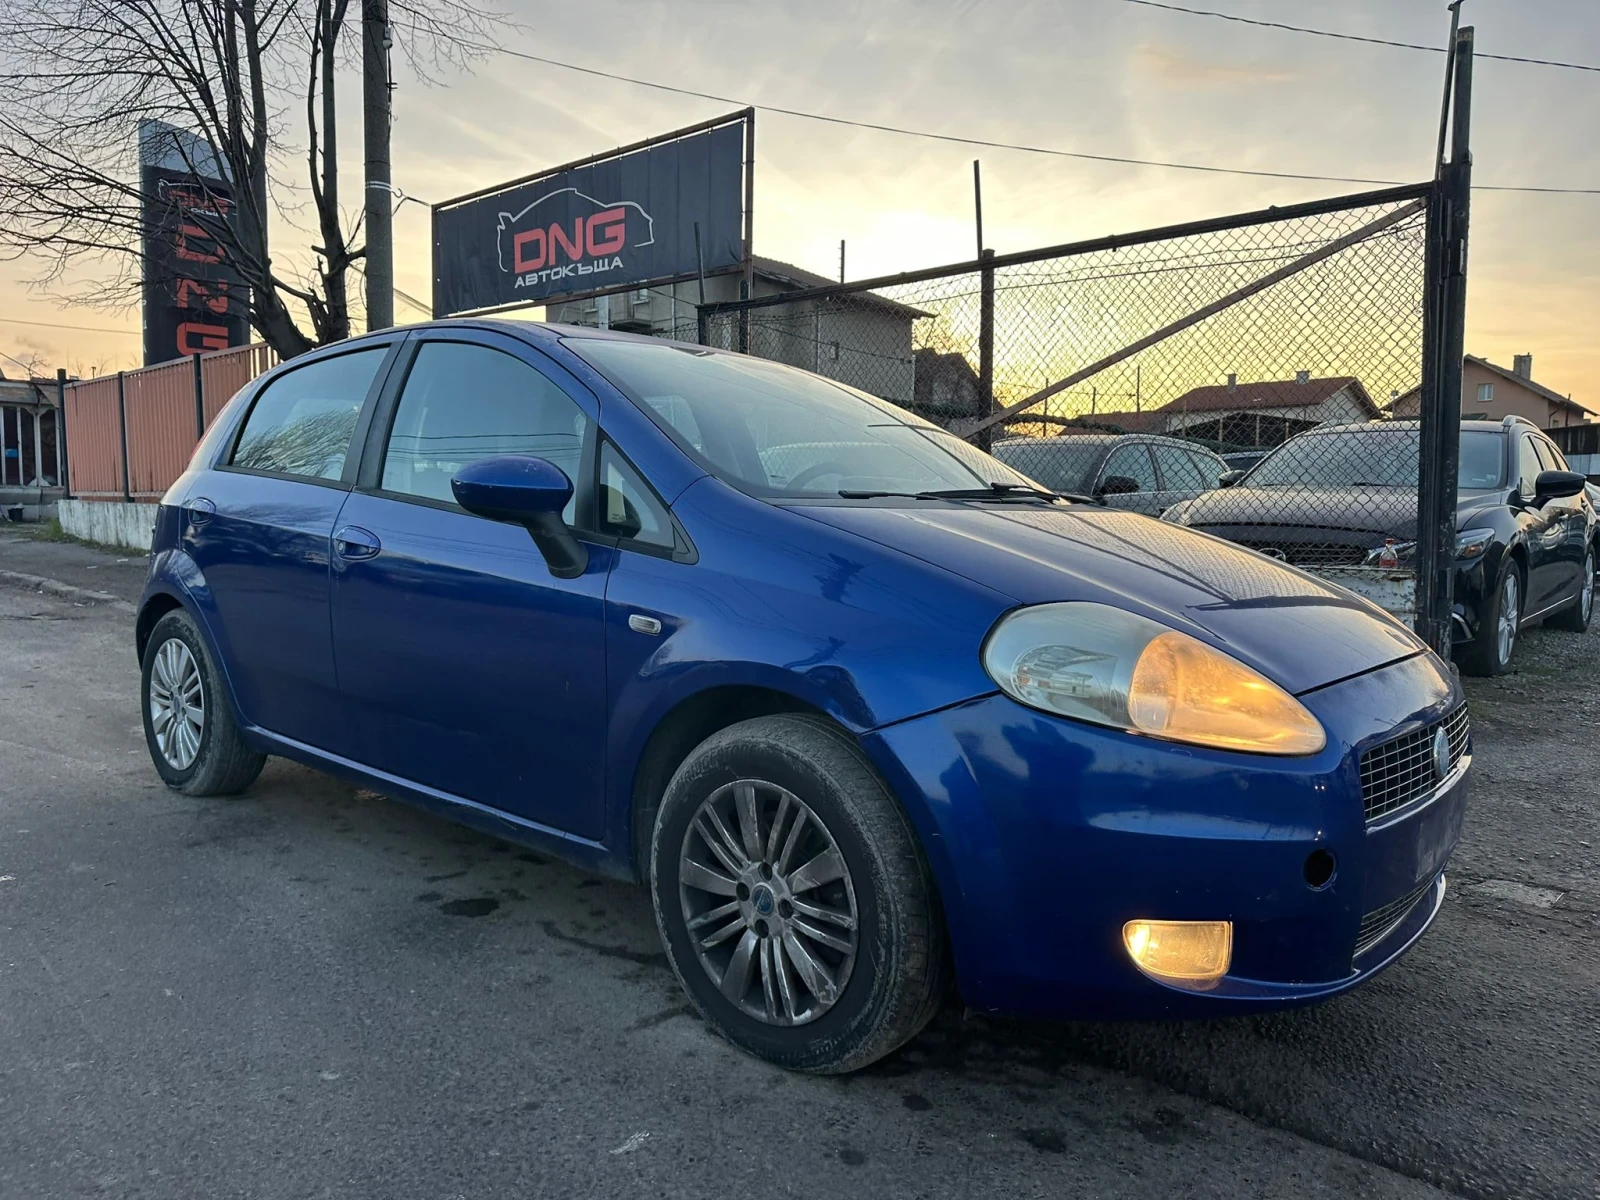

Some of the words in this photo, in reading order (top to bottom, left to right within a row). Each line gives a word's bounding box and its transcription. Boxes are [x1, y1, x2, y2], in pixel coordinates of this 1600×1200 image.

[514, 207, 625, 275] DNG
[514, 256, 624, 289] АВТОКЪЩА
[176, 223, 229, 356] DNG
